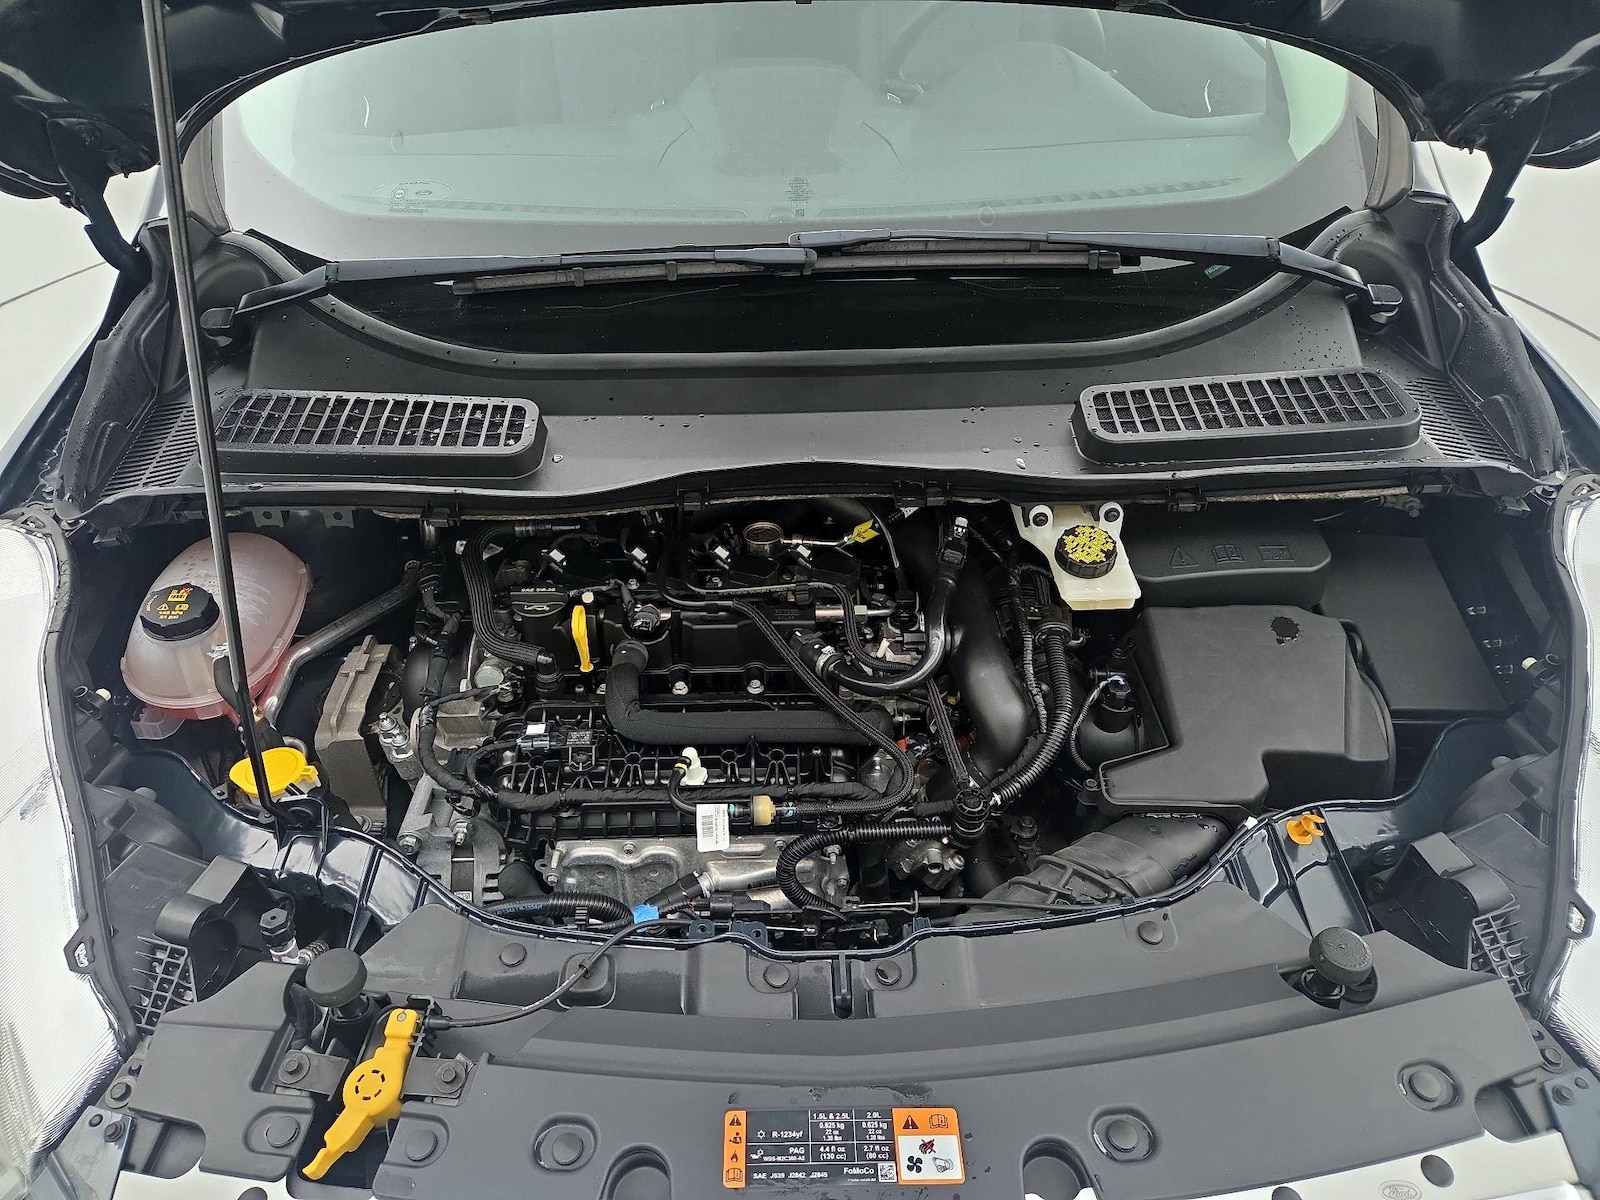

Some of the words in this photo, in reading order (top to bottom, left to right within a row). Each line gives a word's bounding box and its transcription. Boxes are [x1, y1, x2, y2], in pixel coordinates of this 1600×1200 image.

[866, 1111, 882, 1119] 2.0L
[836, 1122, 845, 1130] kg
[862, 1121, 879, 1129] 0.625
[879, 1121, 888, 1130] kg
[771, 1130, 804, 1139] R-1234yf
[866, 1152, 877, 1160] (80
[877, 1152, 890, 1160] cc)
[843, 1167, 875, 1175] FoMoCo
